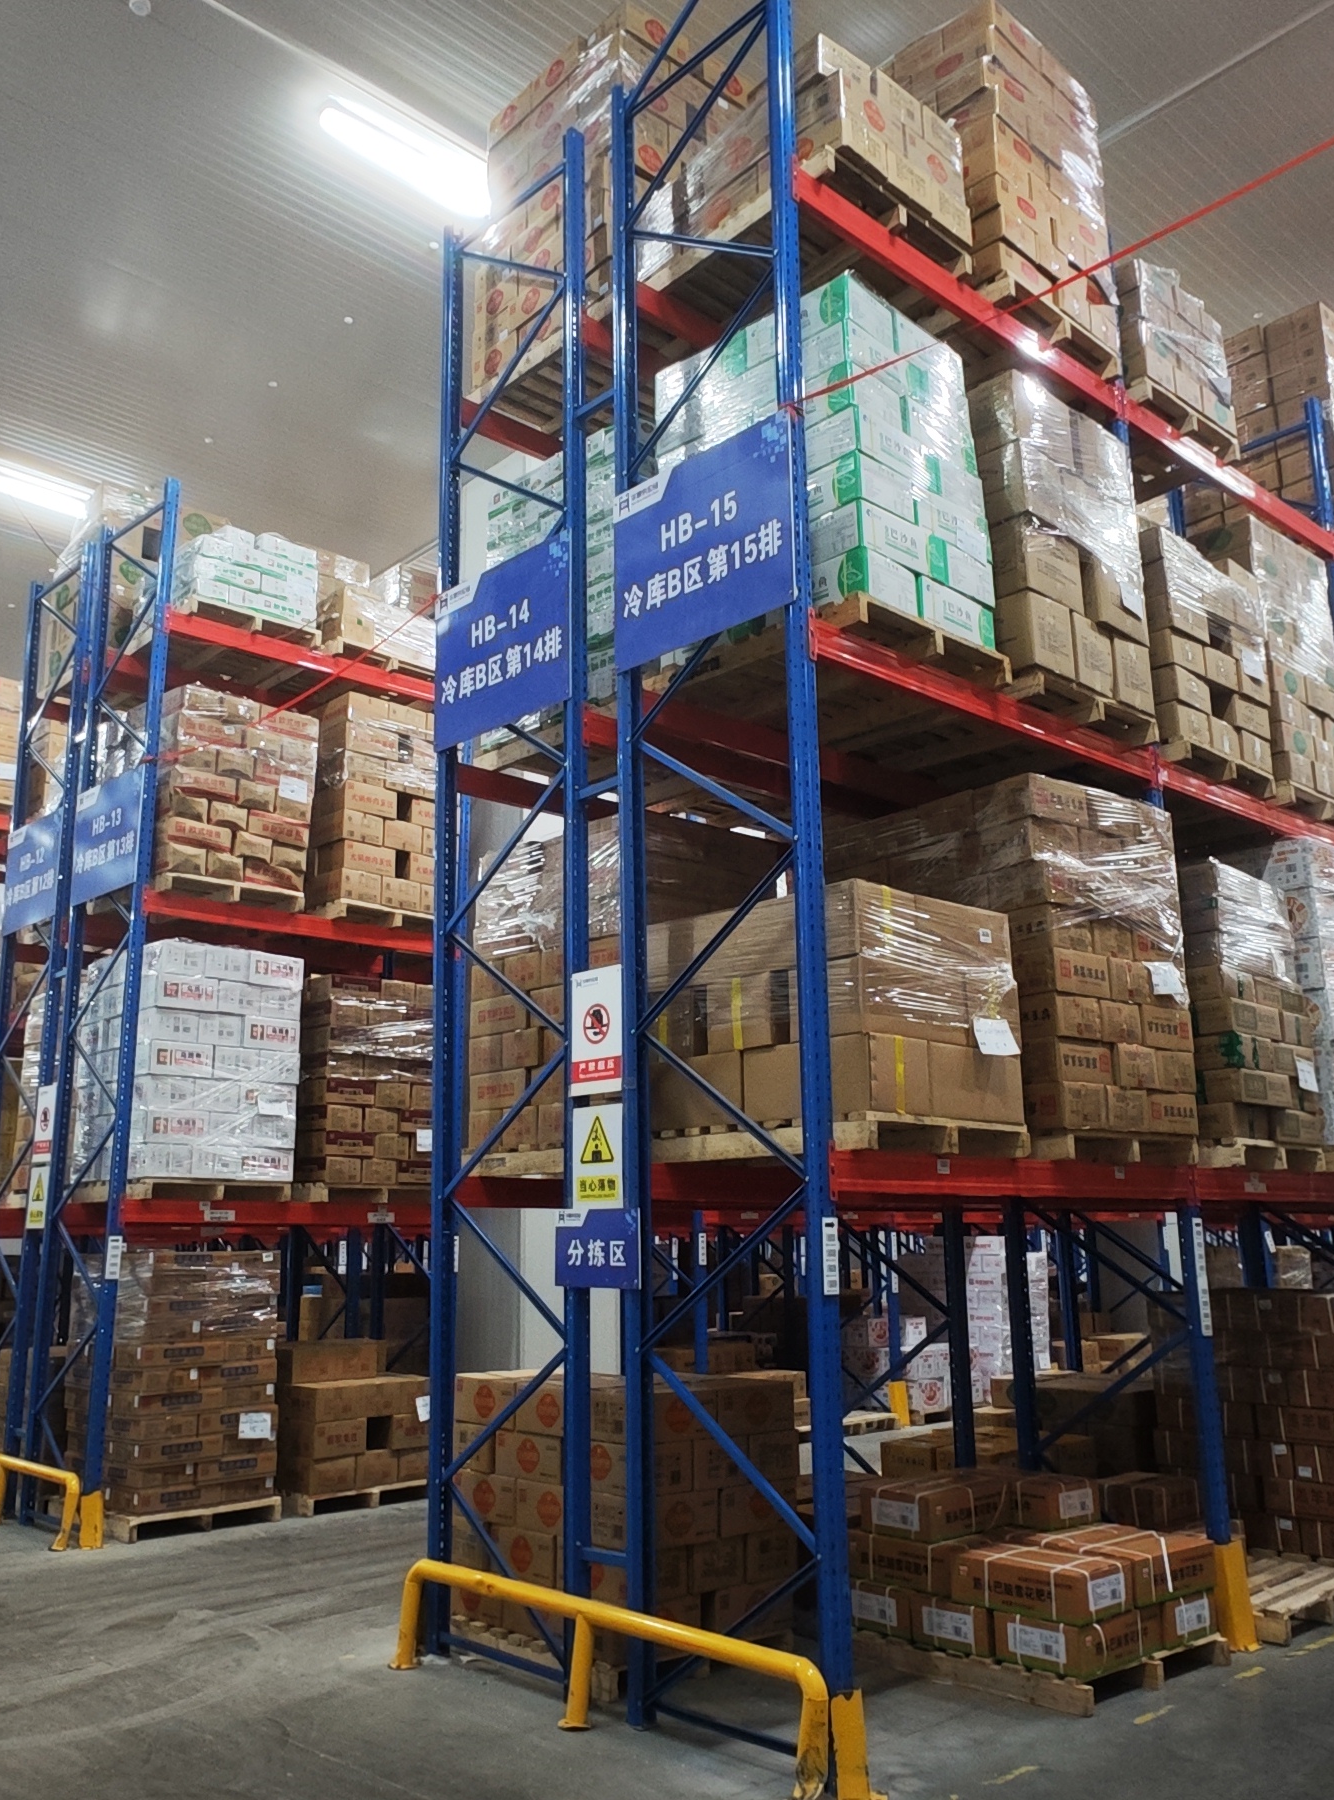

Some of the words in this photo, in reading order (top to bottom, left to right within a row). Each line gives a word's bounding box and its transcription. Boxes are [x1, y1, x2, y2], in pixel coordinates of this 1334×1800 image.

[660, 490, 738, 552] HB-15
[623, 518, 782, 619] 冷库B区第15排
[471, 598, 530, 648] HB-14
[441, 625, 563, 704] 冷库B区第14排
[92, 807, 122, 836] HB-13
[568, 1239, 626, 1267] 分拣区
